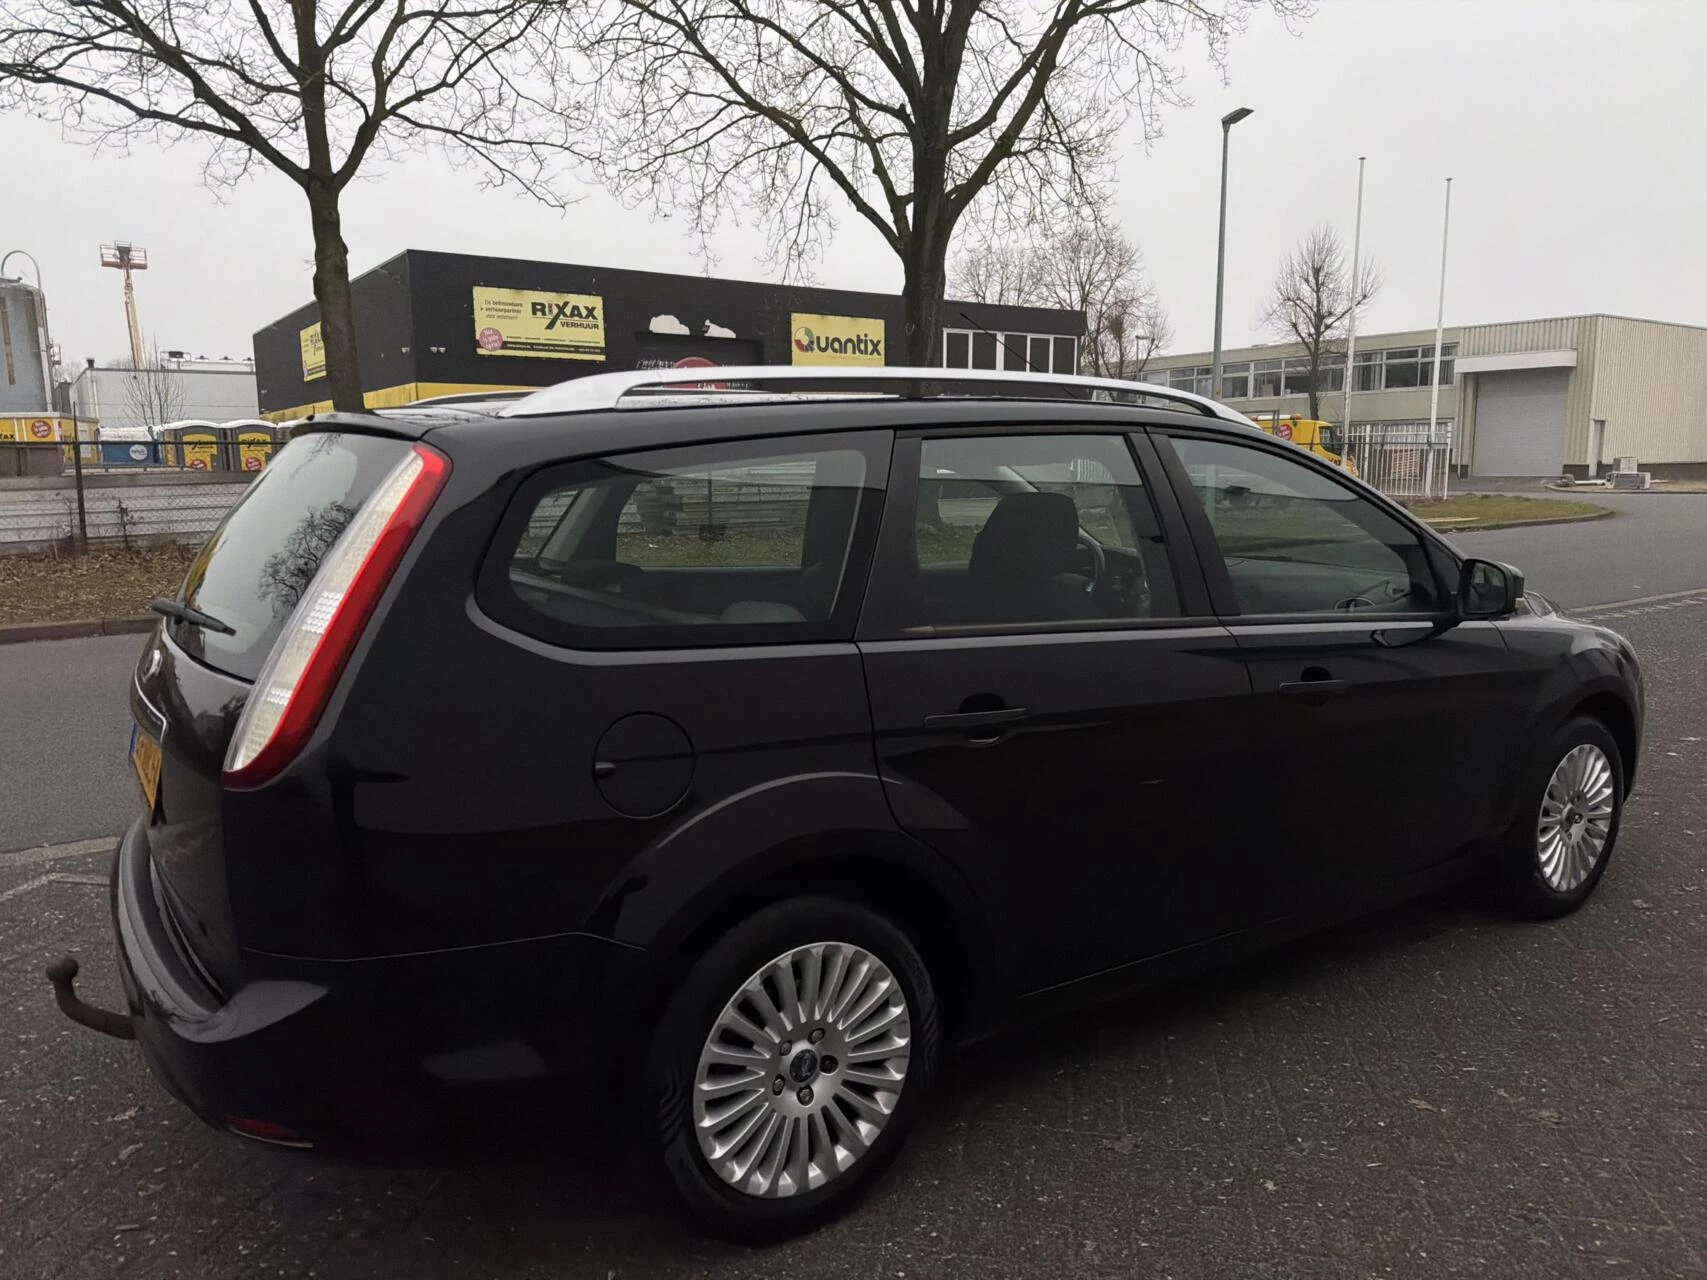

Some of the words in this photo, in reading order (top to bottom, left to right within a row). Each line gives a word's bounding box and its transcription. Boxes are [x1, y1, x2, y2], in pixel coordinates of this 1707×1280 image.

[531, 300, 599, 330] RIXAX
[560, 321, 599, 330] VERHUUR
[794, 326, 882, 356] Quantix
